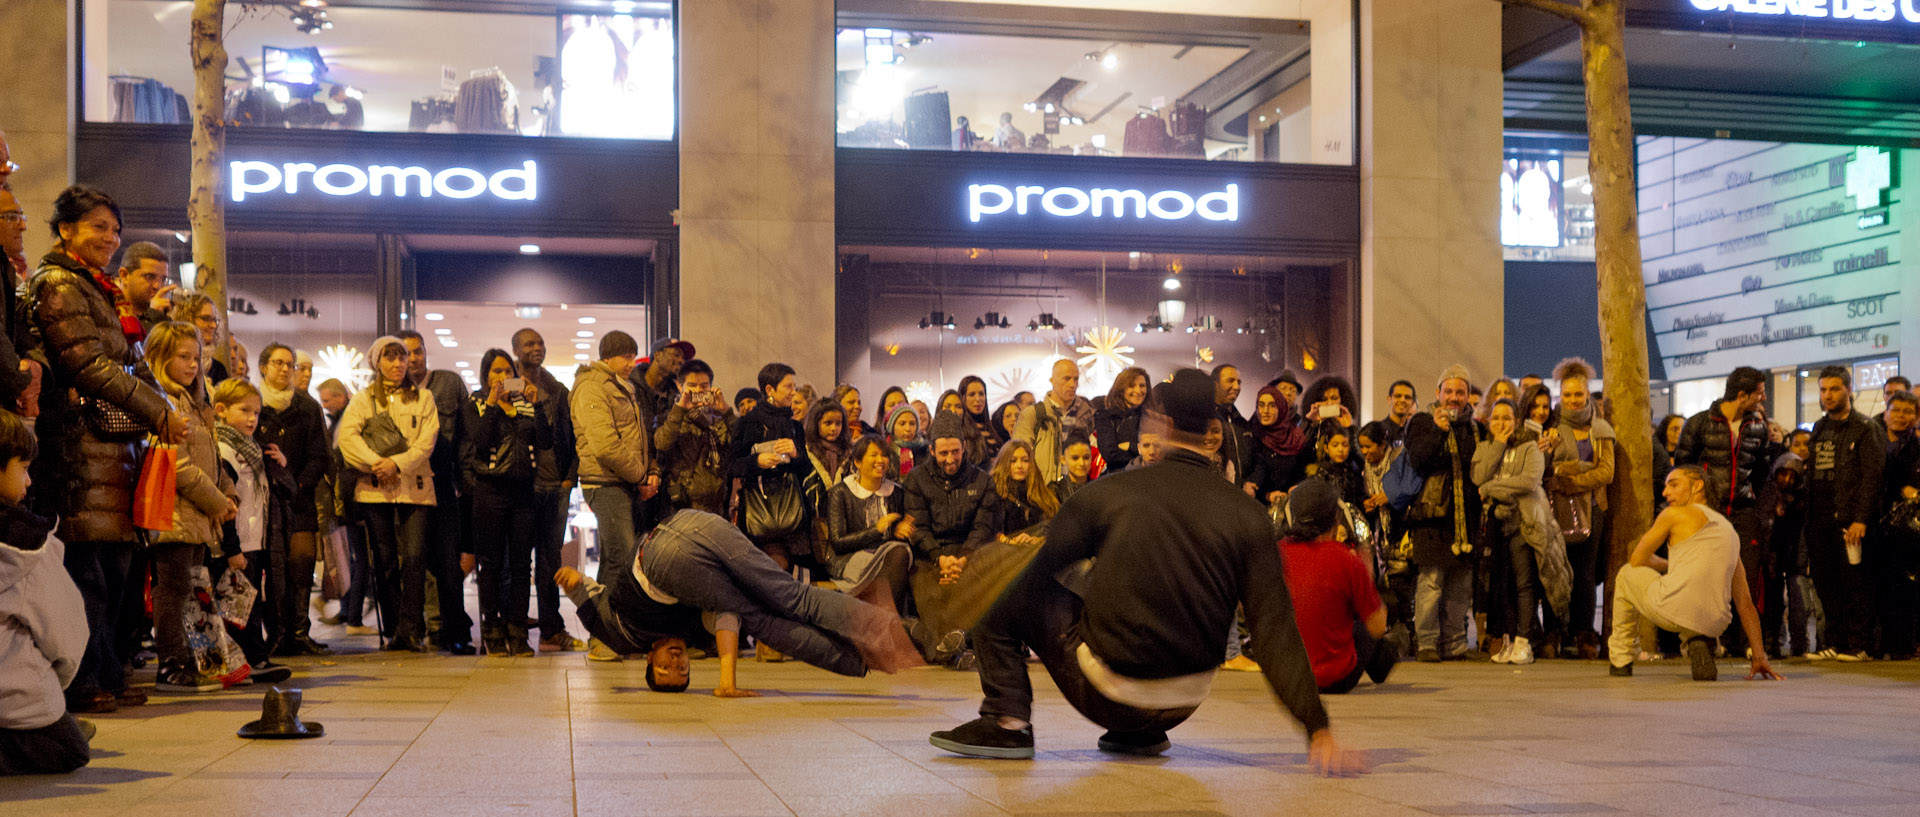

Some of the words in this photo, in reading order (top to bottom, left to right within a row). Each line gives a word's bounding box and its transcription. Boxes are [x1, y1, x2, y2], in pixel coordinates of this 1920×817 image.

[1831, 0, 1895, 21] DES
[230, 160, 537, 201] promod
[968, 183, 1238, 222] promod
[1834, 247, 1888, 274] minelli
[1848, 296, 1886, 318] SCOT
[1716, 333, 1759, 350] CHRISTIAN
[1840, 329, 1868, 345] RACK
[1673, 353, 1706, 367] CHANGE
